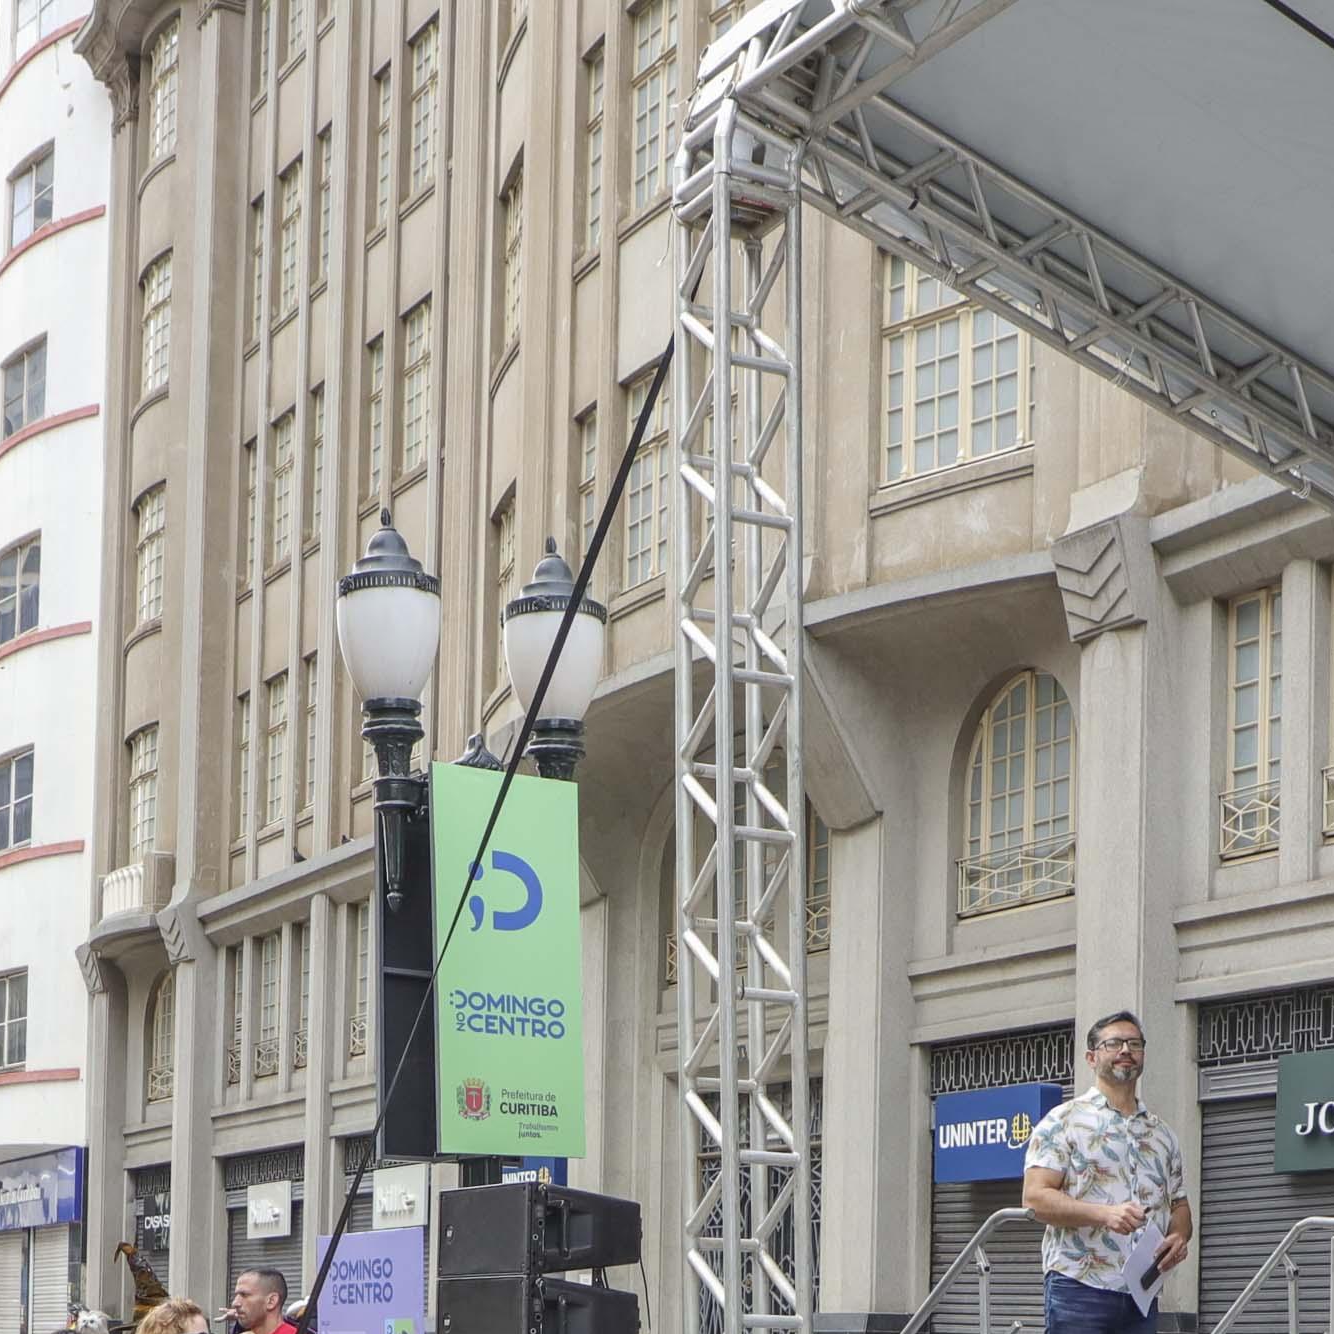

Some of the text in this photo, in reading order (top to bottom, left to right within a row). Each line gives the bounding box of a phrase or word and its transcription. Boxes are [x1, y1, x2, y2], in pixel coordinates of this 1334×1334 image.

[467, 1014, 565, 1039] CENTRO
[501, 1088, 556, 1102] Prefeitura de
[499, 1102, 558, 1117] CURITIBA
[939, 1118, 1007, 1149] UNINTER
[338, 1282, 393, 1304] CENTRO
